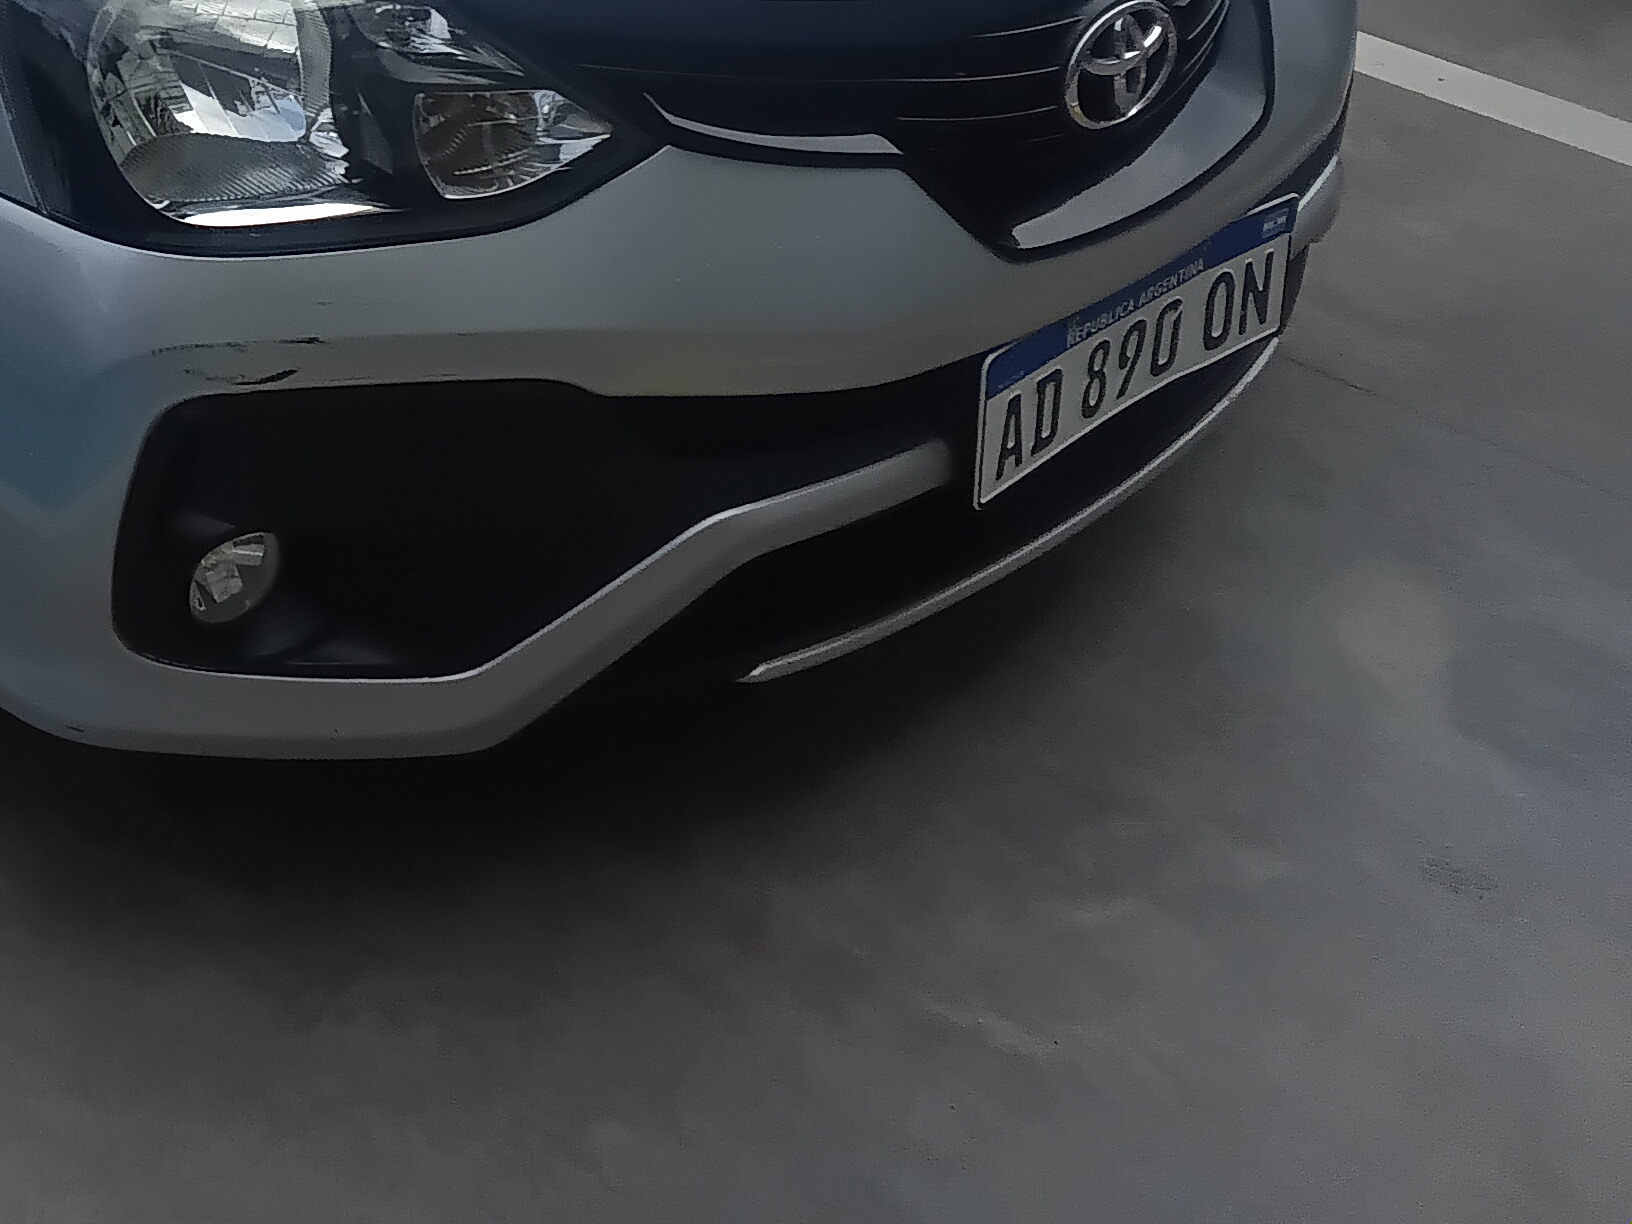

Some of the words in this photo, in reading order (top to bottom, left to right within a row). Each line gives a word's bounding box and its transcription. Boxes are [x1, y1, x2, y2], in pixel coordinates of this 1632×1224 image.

[1138, 257, 1205, 308] ARGENTINA
[995, 367, 1063, 481] AD
[1081, 297, 1183, 419] 890
[1203, 249, 1275, 351] ON
